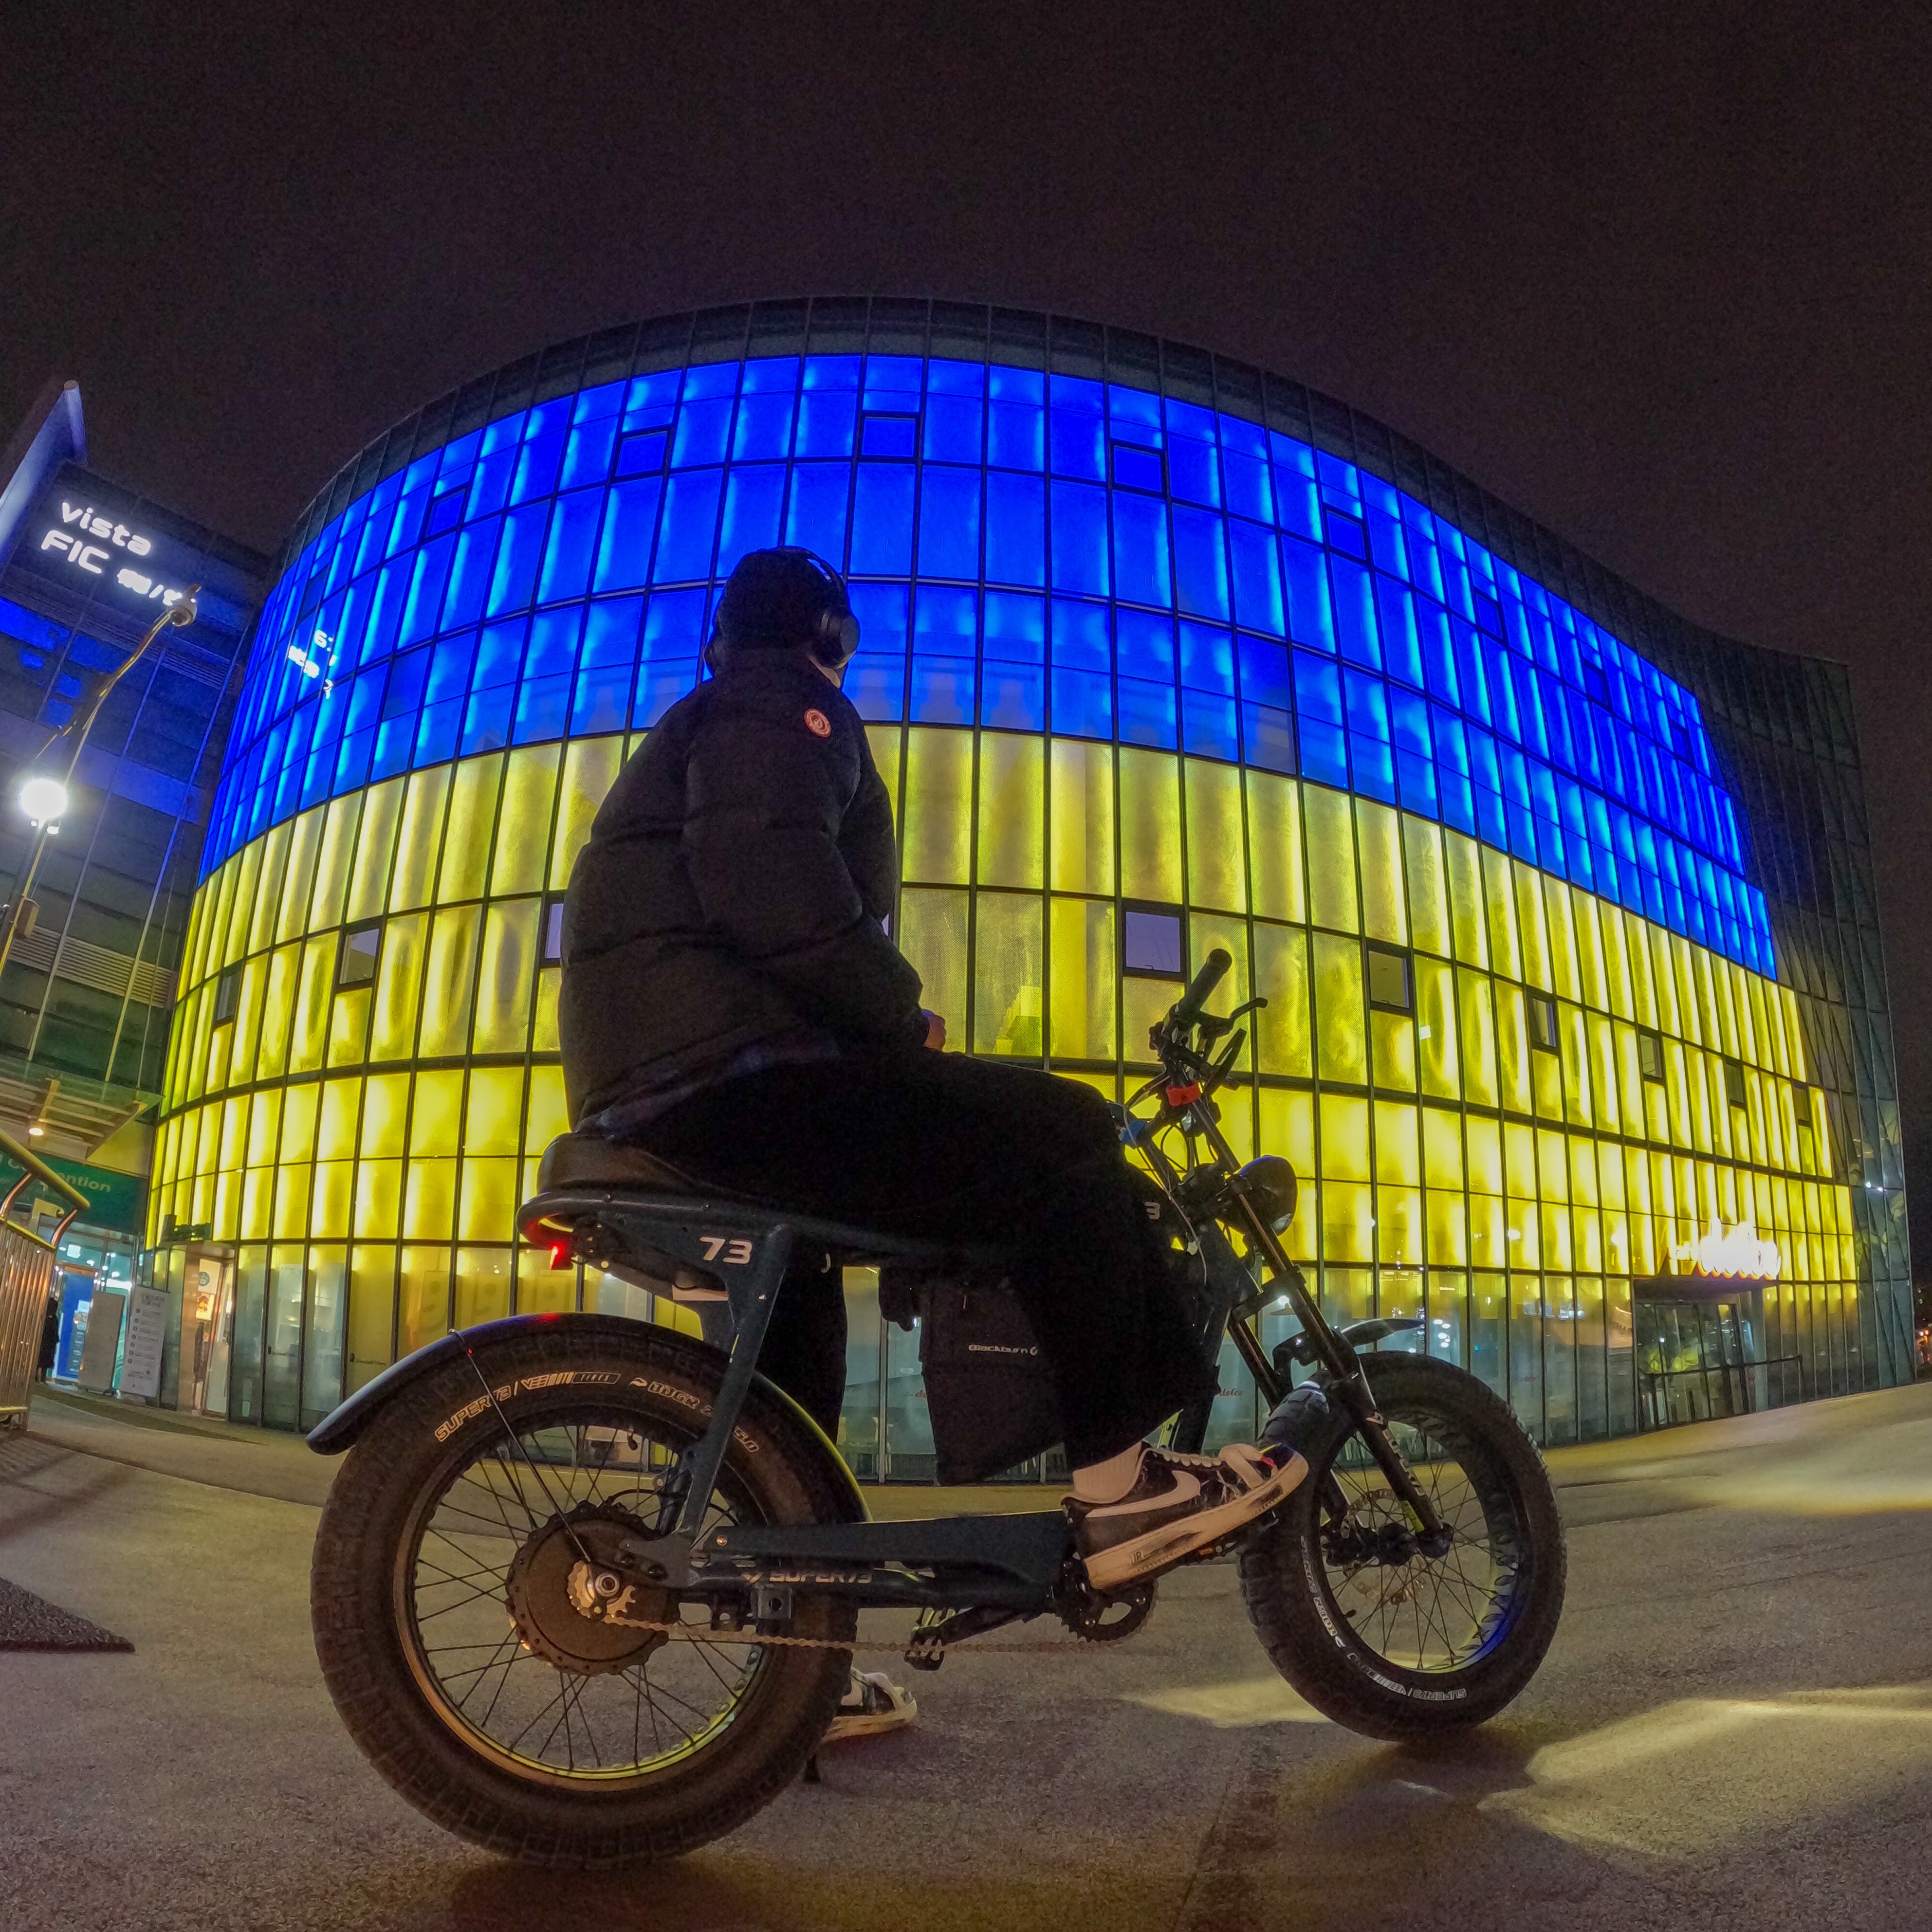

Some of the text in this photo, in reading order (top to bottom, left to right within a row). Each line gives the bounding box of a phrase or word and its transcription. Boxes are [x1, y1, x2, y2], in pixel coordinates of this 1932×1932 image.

[61, 502, 151, 556] vista
[41, 530, 109, 574] FIC
[699, 1237, 753, 1264] 73
